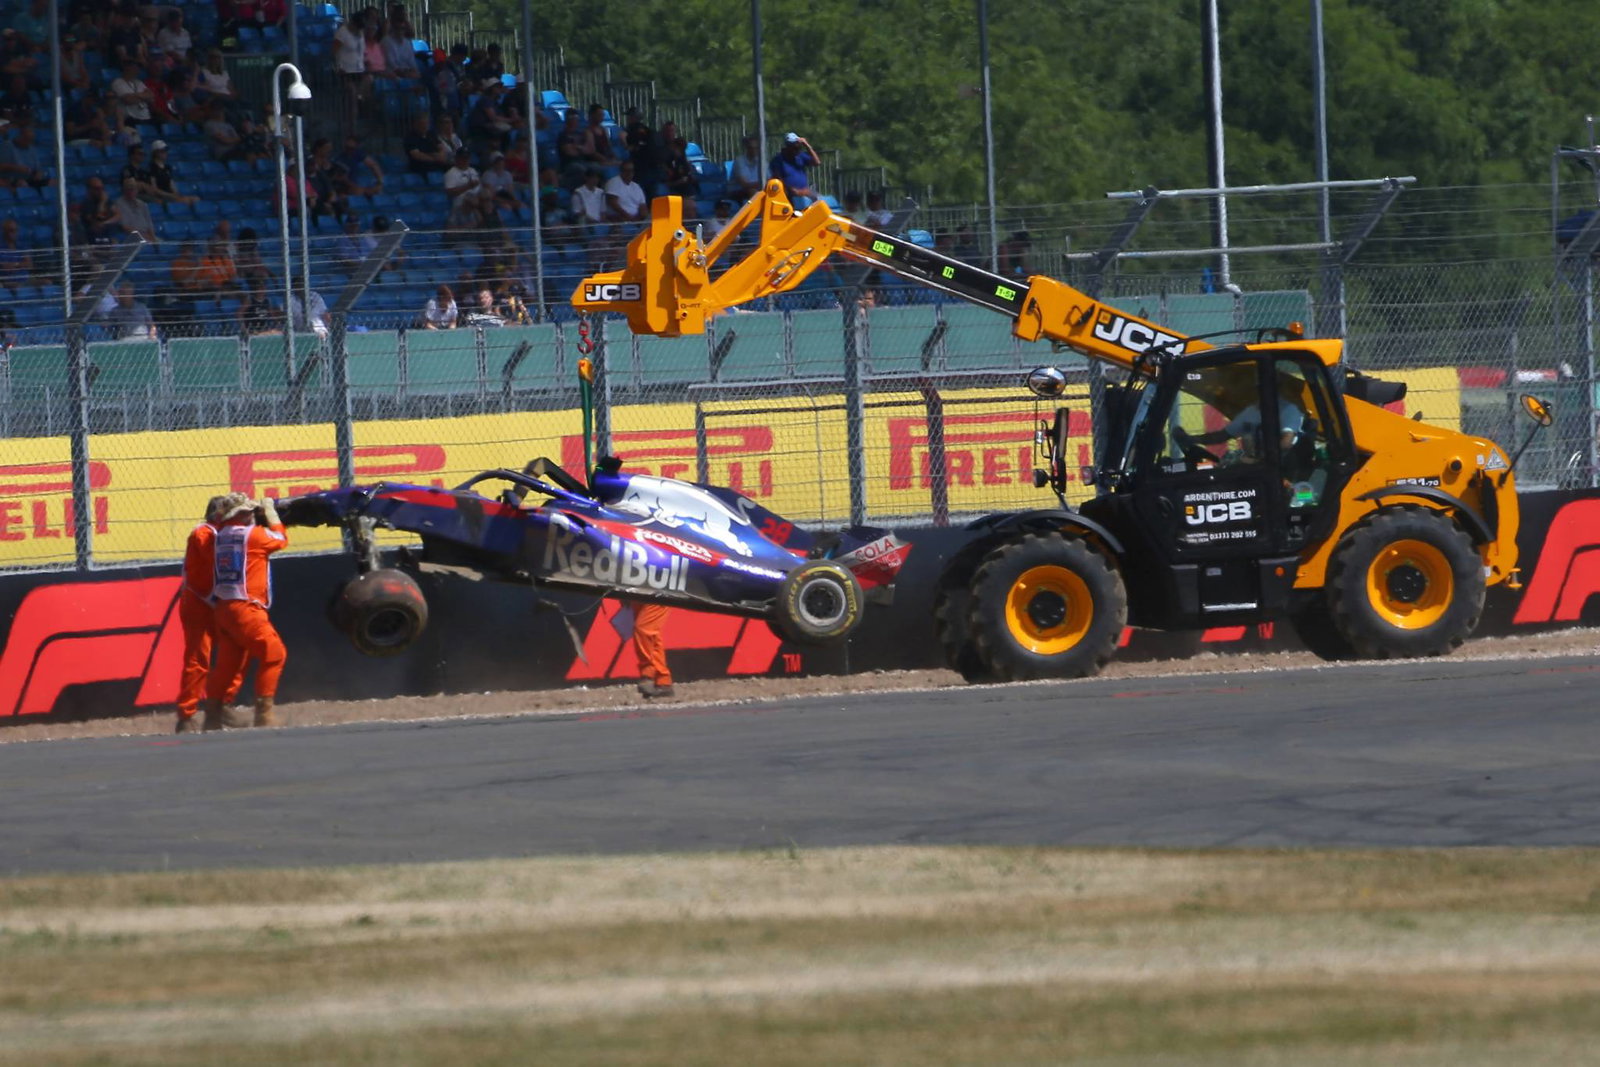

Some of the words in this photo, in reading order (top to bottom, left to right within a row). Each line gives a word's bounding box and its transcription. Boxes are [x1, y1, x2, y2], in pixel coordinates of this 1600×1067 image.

[585, 284, 640, 301] JCB
[889, 410, 1093, 490] PIRELI
[1185, 501, 1252, 525] JCB
[633, 528, 713, 558] HONDA
[855, 538, 895, 564] COLA
[782, 653, 802, 673] TM
